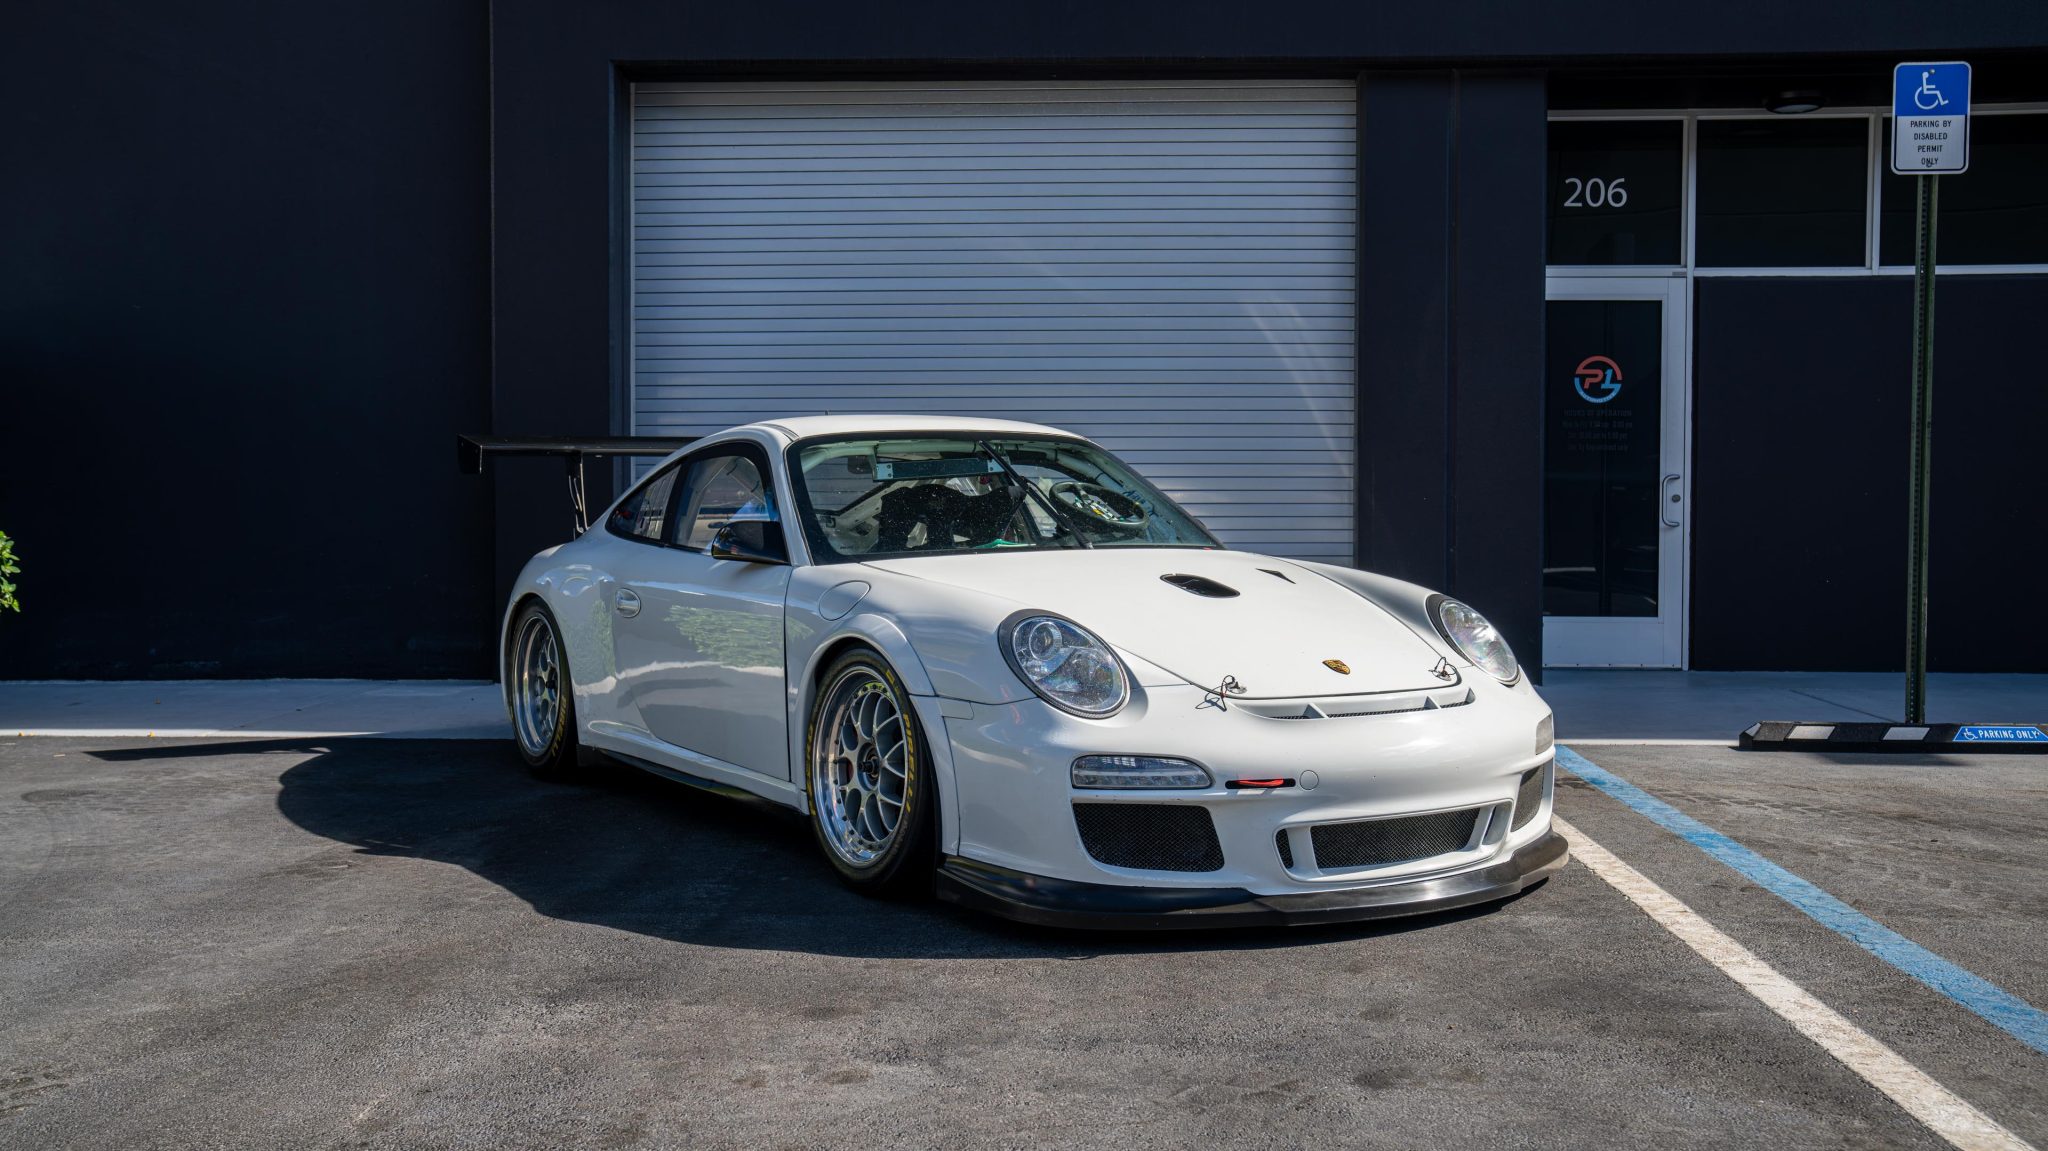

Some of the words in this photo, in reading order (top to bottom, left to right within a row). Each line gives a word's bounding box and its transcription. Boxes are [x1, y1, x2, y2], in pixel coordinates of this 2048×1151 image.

[1910, 120, 1940, 128] PARKING
[1913, 132, 1948, 140] DISABLED
[1563, 177, 1628, 207] 206
[1978, 730, 2014, 739] PARKING
[2016, 730, 2037, 739] ONLY
[903, 713, 915, 813] PIRELLI
